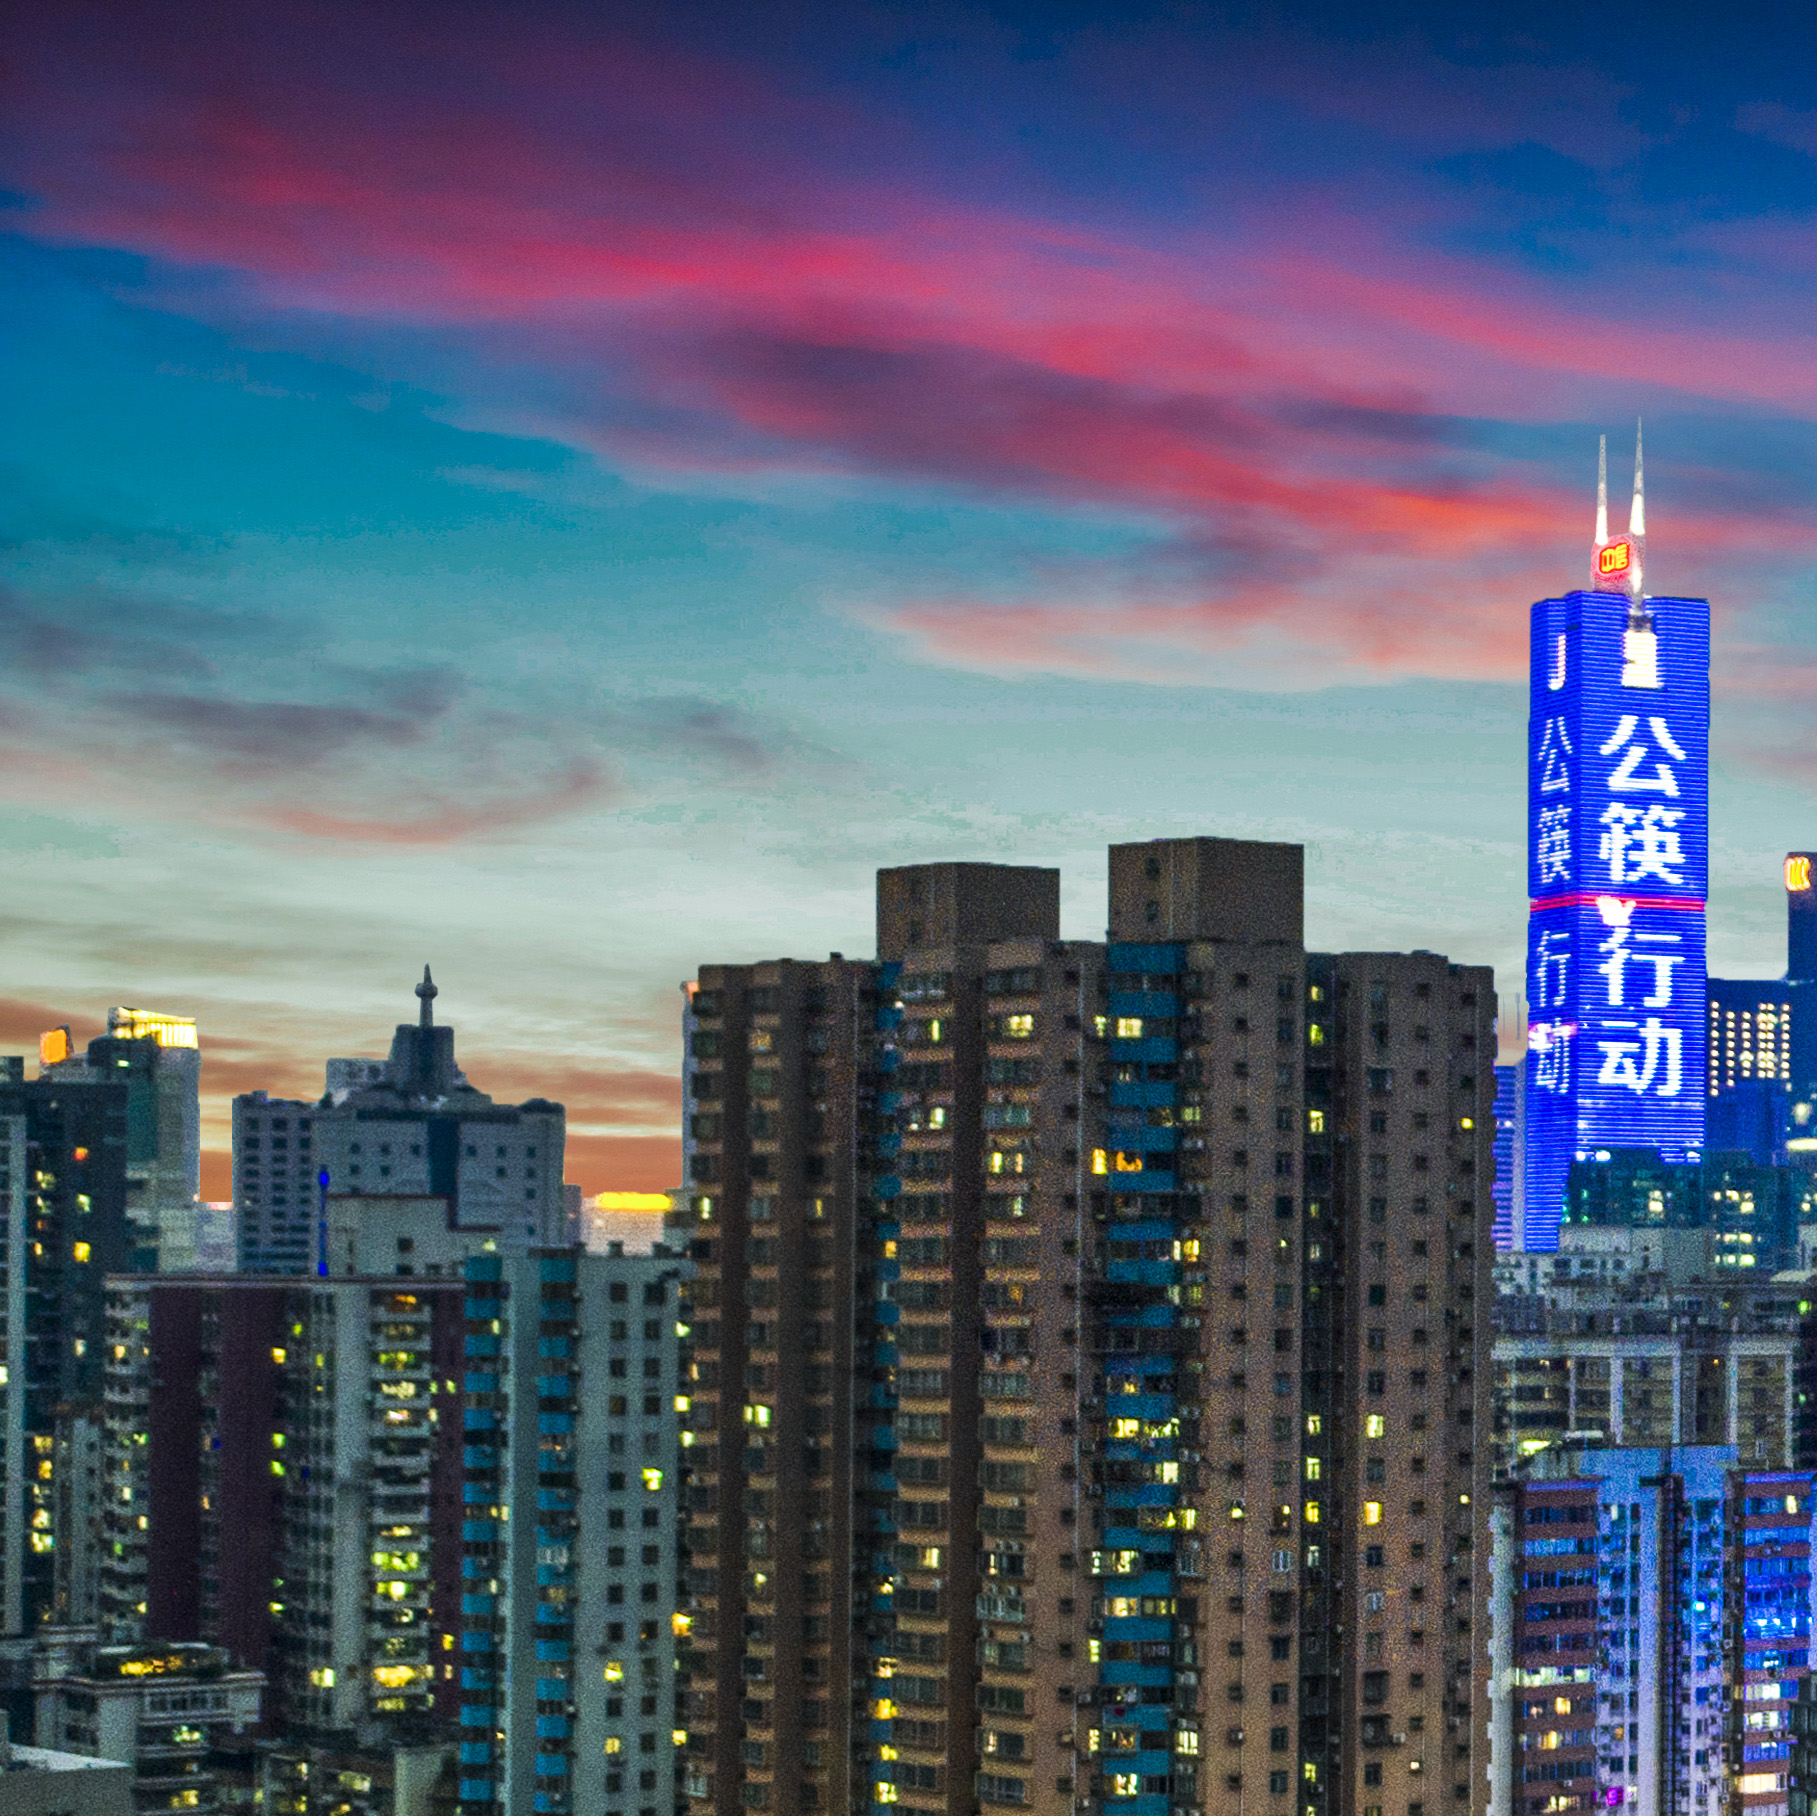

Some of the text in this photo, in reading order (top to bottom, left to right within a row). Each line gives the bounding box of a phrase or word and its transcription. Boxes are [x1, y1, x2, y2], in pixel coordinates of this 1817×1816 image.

[1536, 716, 1571, 1095] 公筷行动
[1598, 714, 1688, 1097] 公筷行动
